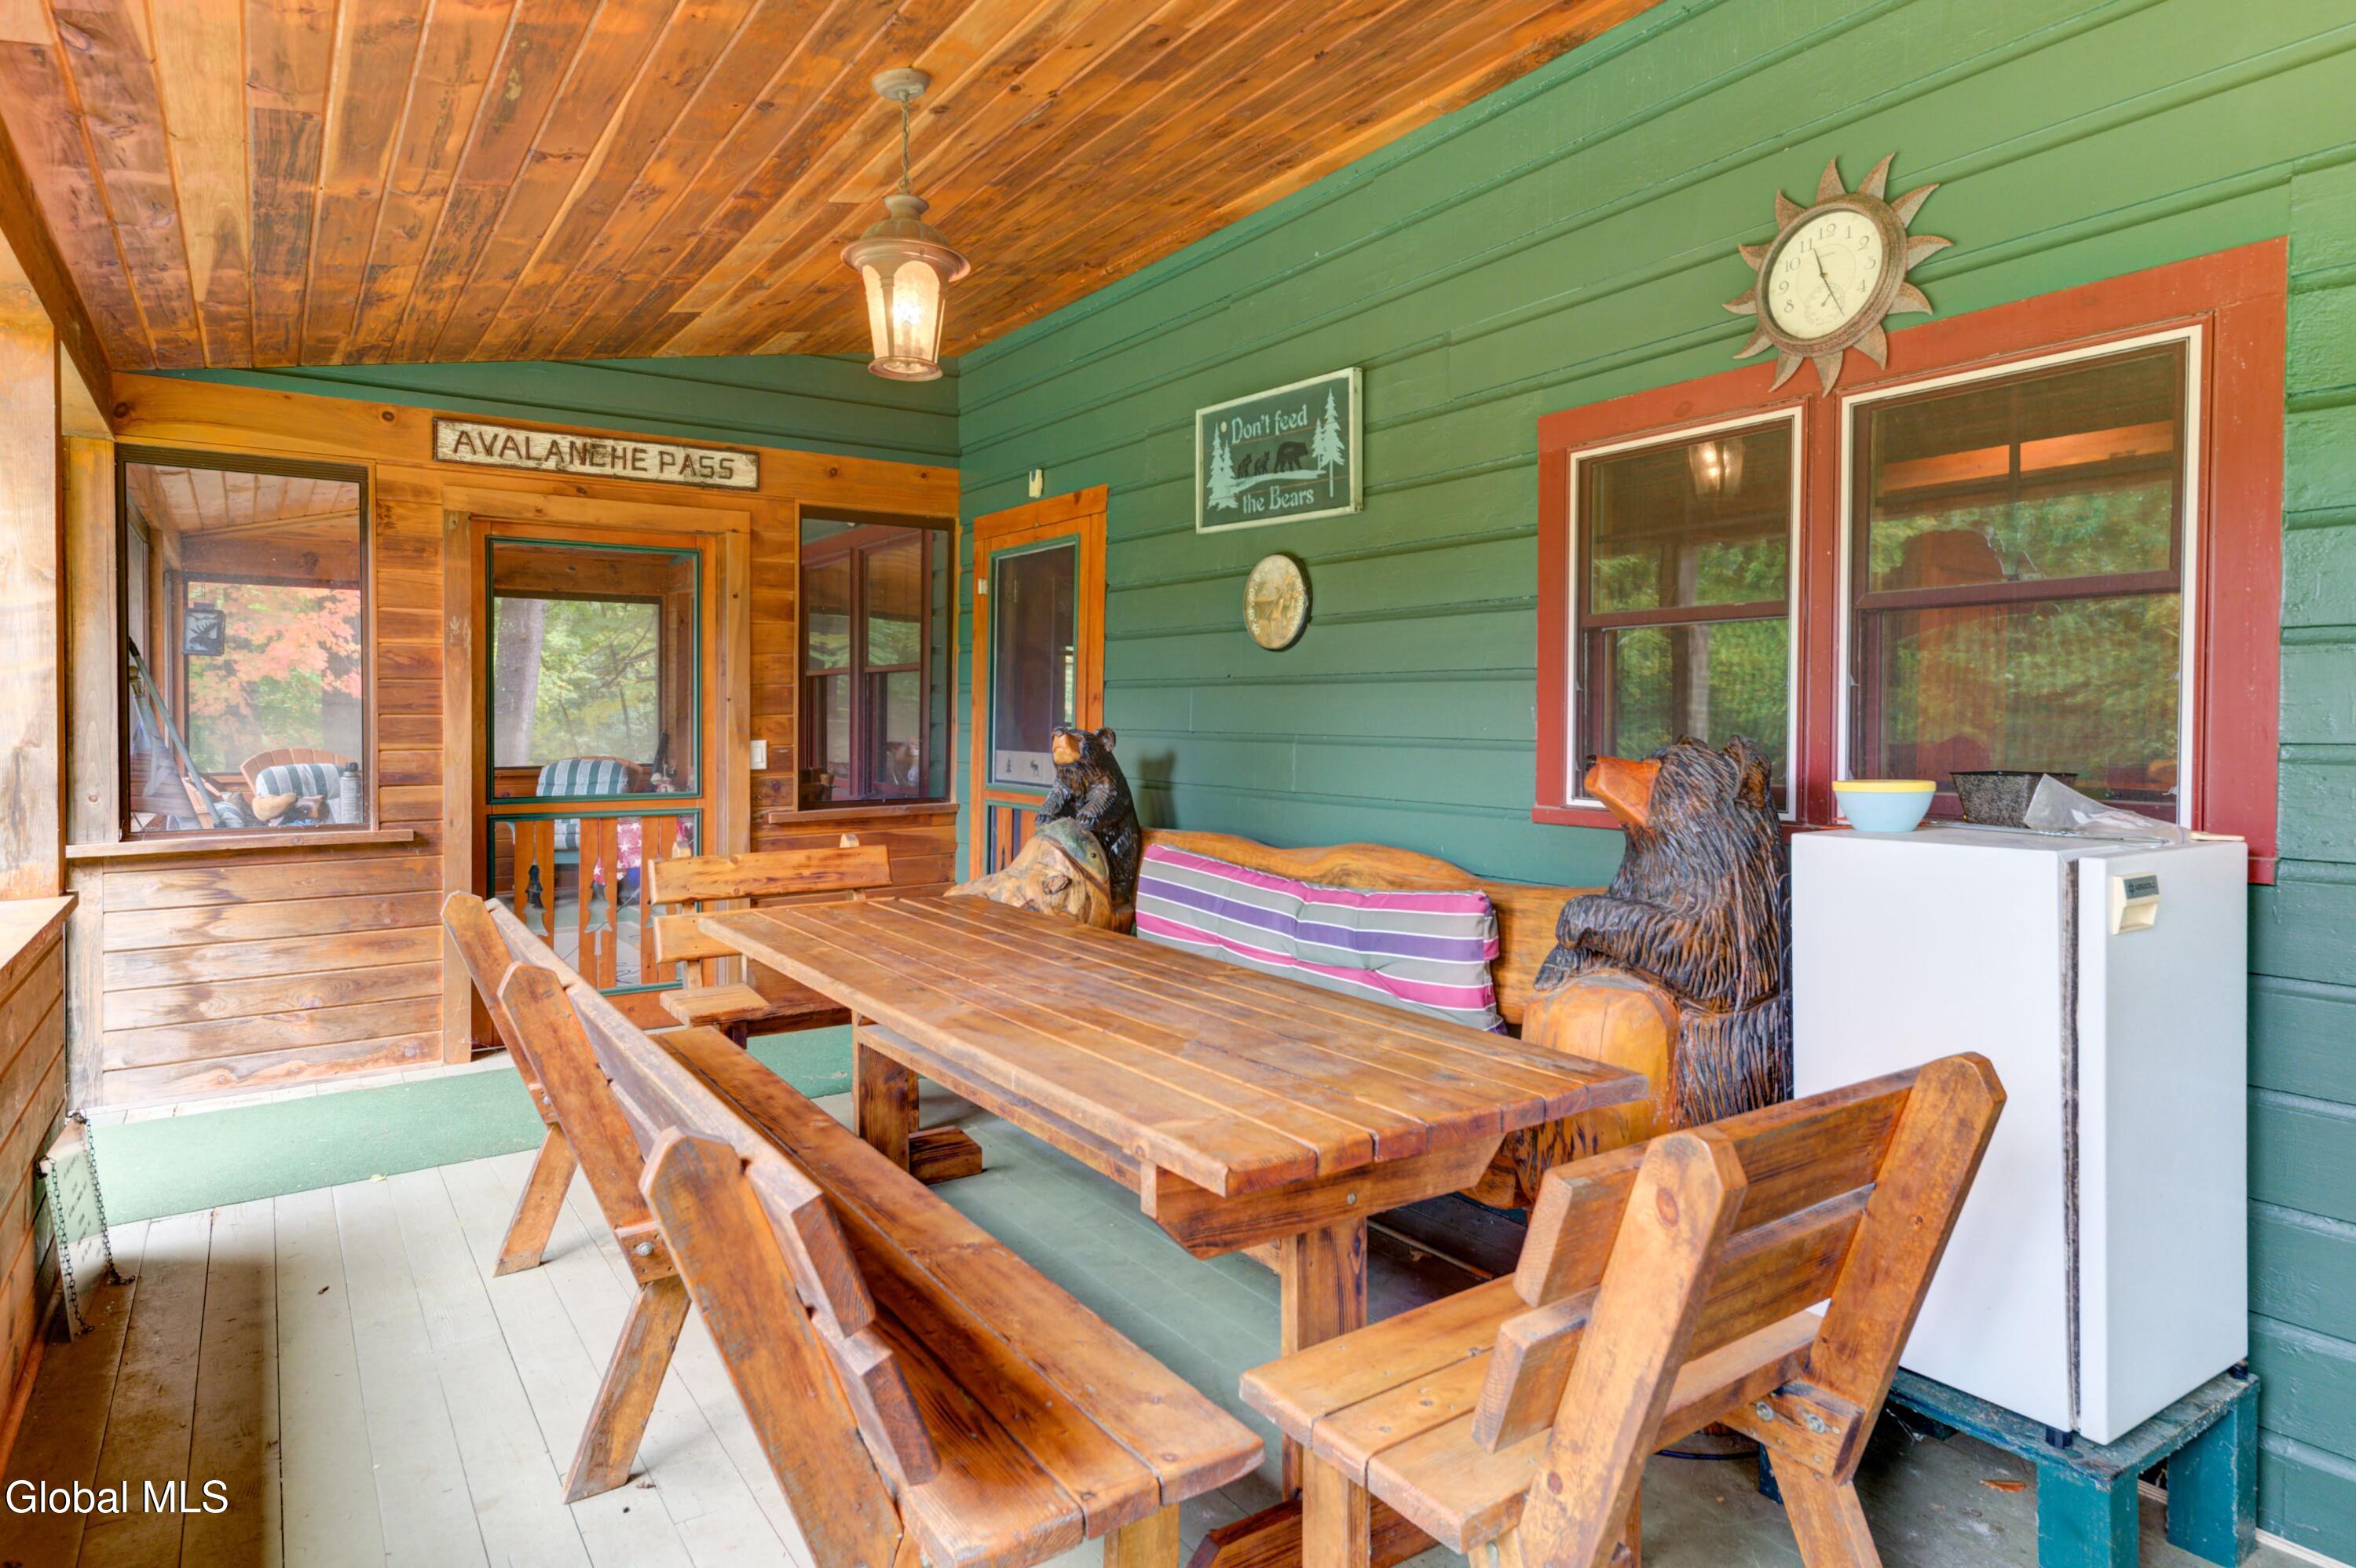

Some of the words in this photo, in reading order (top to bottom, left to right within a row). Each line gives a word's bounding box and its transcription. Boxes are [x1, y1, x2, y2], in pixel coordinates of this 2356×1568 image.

[1818, 223, 1836, 240] 12
[1846, 225, 1852, 239] 1
[1799, 238, 1814, 253] 11
[1857, 236, 1870, 251] 2
[1784, 257, 1801, 272] 10
[1864, 256, 1877, 270] 3
[1777, 280, 1790, 295] 9
[1857, 279, 1868, 293] 4
[1783, 299, 1794, 313] 8
[1231, 414, 1271, 445] Don't
[1275, 404, 1308, 436] feed
[452, 429, 648, 473] AVALANCHE
[658, 450, 734, 480] PASS
[1243, 495, 1265, 514] the
[1269, 484, 1315, 510] Bears
